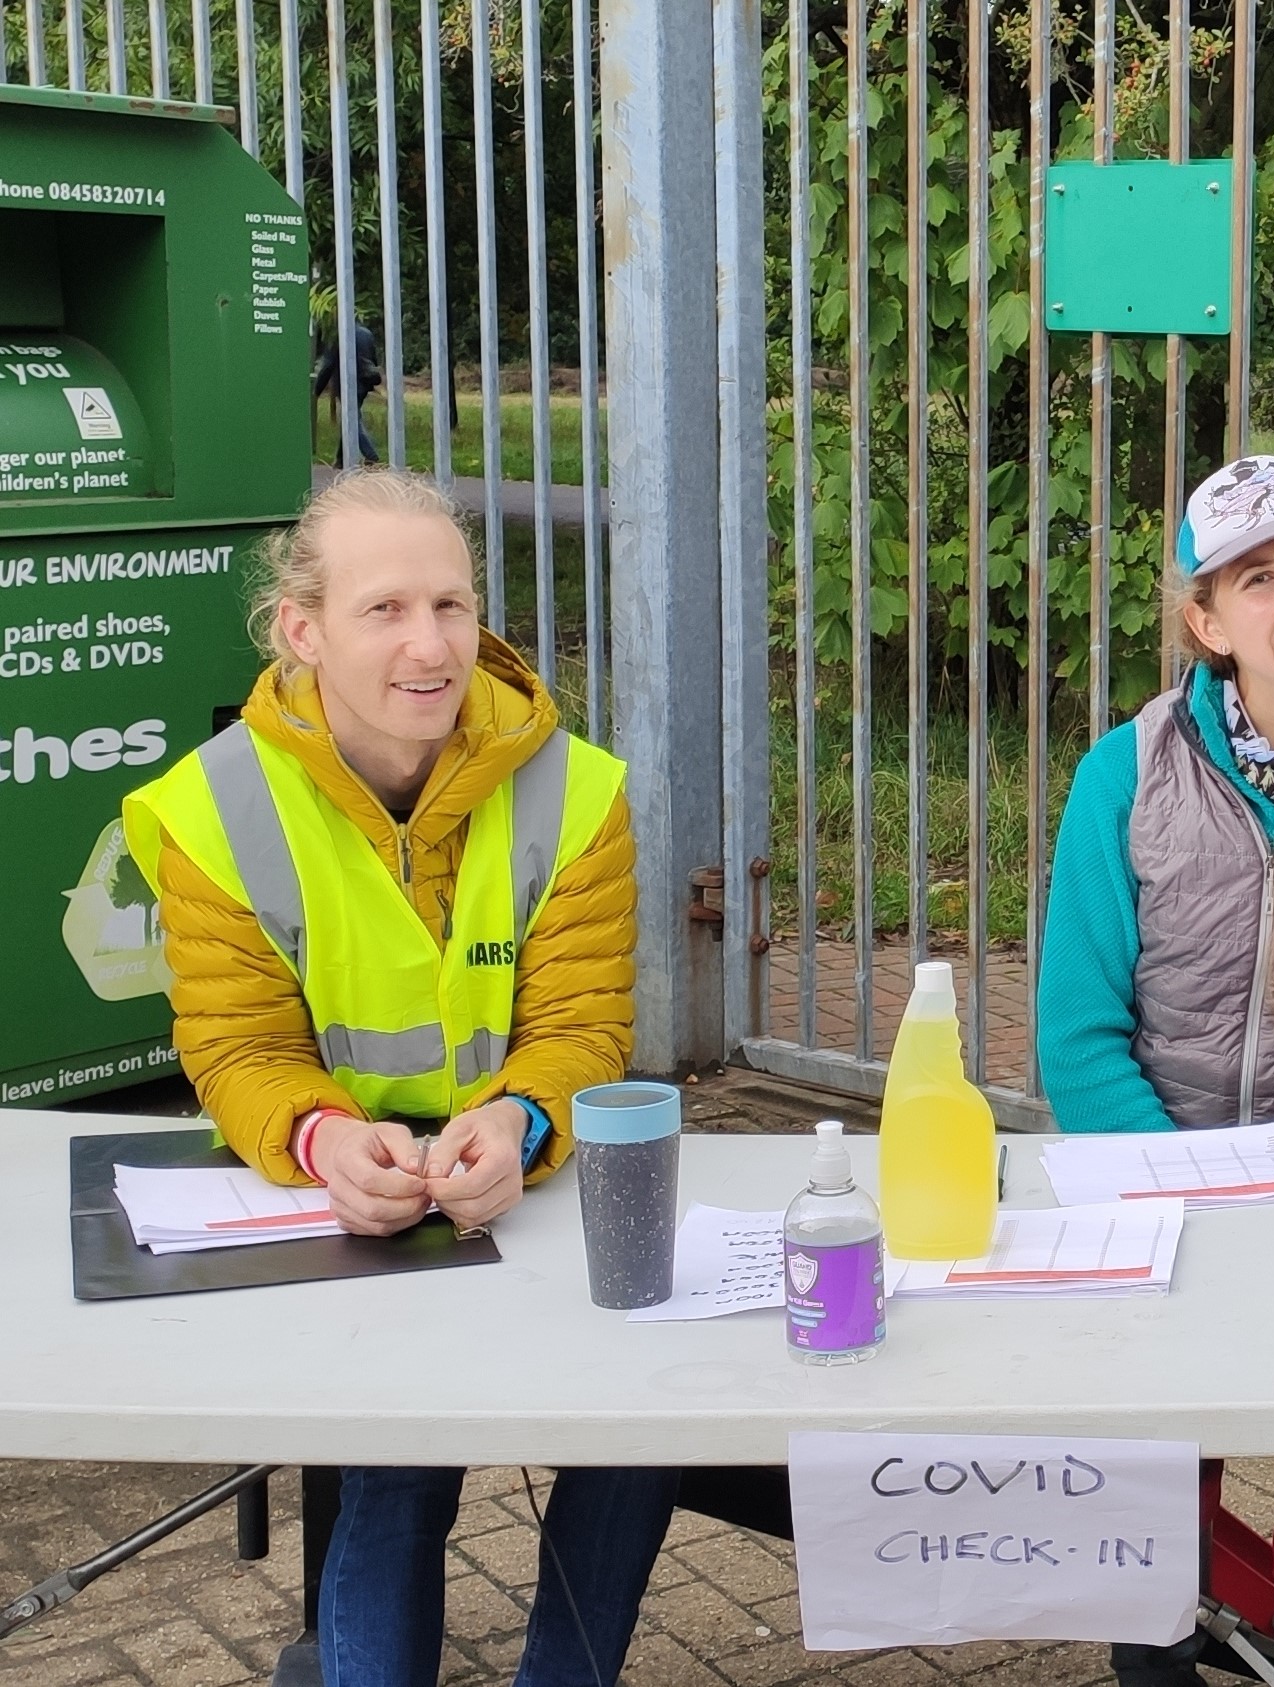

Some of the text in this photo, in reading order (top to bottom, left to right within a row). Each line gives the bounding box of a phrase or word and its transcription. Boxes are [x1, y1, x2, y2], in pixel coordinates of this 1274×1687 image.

[49, 182, 165, 206] 08458320714
[245, 213, 303, 225] NO THANKS
[251, 230, 277, 241] Soiled
[251, 244, 274, 254] Glass
[251, 257, 276, 267] Metal
[252, 284, 278, 296] Paper
[253, 310, 279, 320] Duvet
[254, 323, 282, 333] Pillows
[10, 344, 62, 358] bags
[5, 363, 71, 385] you
[34, 451, 66, 465] our
[71, 447, 126, 469] planet
[0, 471, 129, 493] ildren's planet
[0, 546, 234, 588] UR ENVIRONMENT
[5, 612, 170, 651] paired shoes,
[0, 641, 163, 677] CDs & DVDs
[2, 1045, 178, 1102] leave items on the
[871, 1454, 1106, 1496] COVID
[874, 1530, 1154, 1567] CHECK-IN
